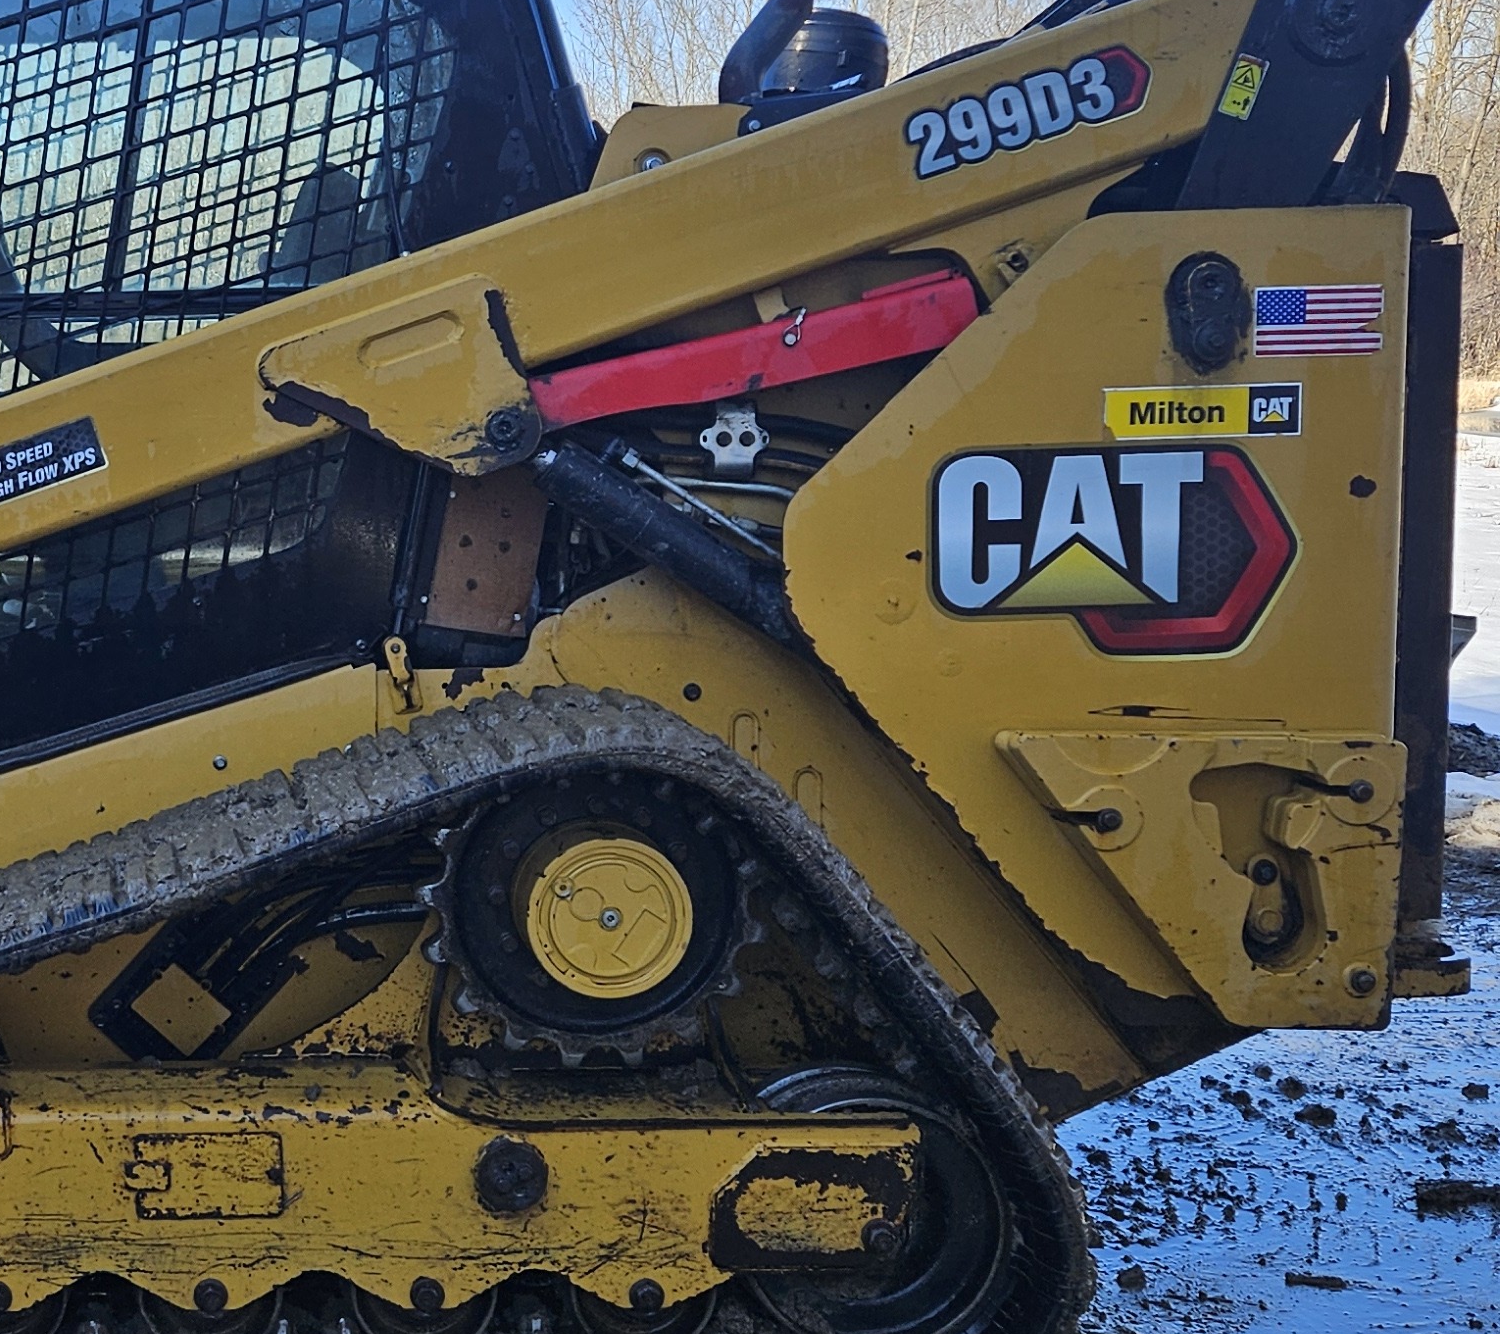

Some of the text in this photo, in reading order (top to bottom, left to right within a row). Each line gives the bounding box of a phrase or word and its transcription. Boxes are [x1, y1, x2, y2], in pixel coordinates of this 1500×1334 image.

[908, 58, 1115, 176] 299D3
[1129, 396, 1293, 426] Milton CAT
[5, 441, 53, 470] SPEED
[17, 462, 58, 490] FLOW
[62, 447, 96, 474] XPS
[938, 451, 1204, 609] CAT
